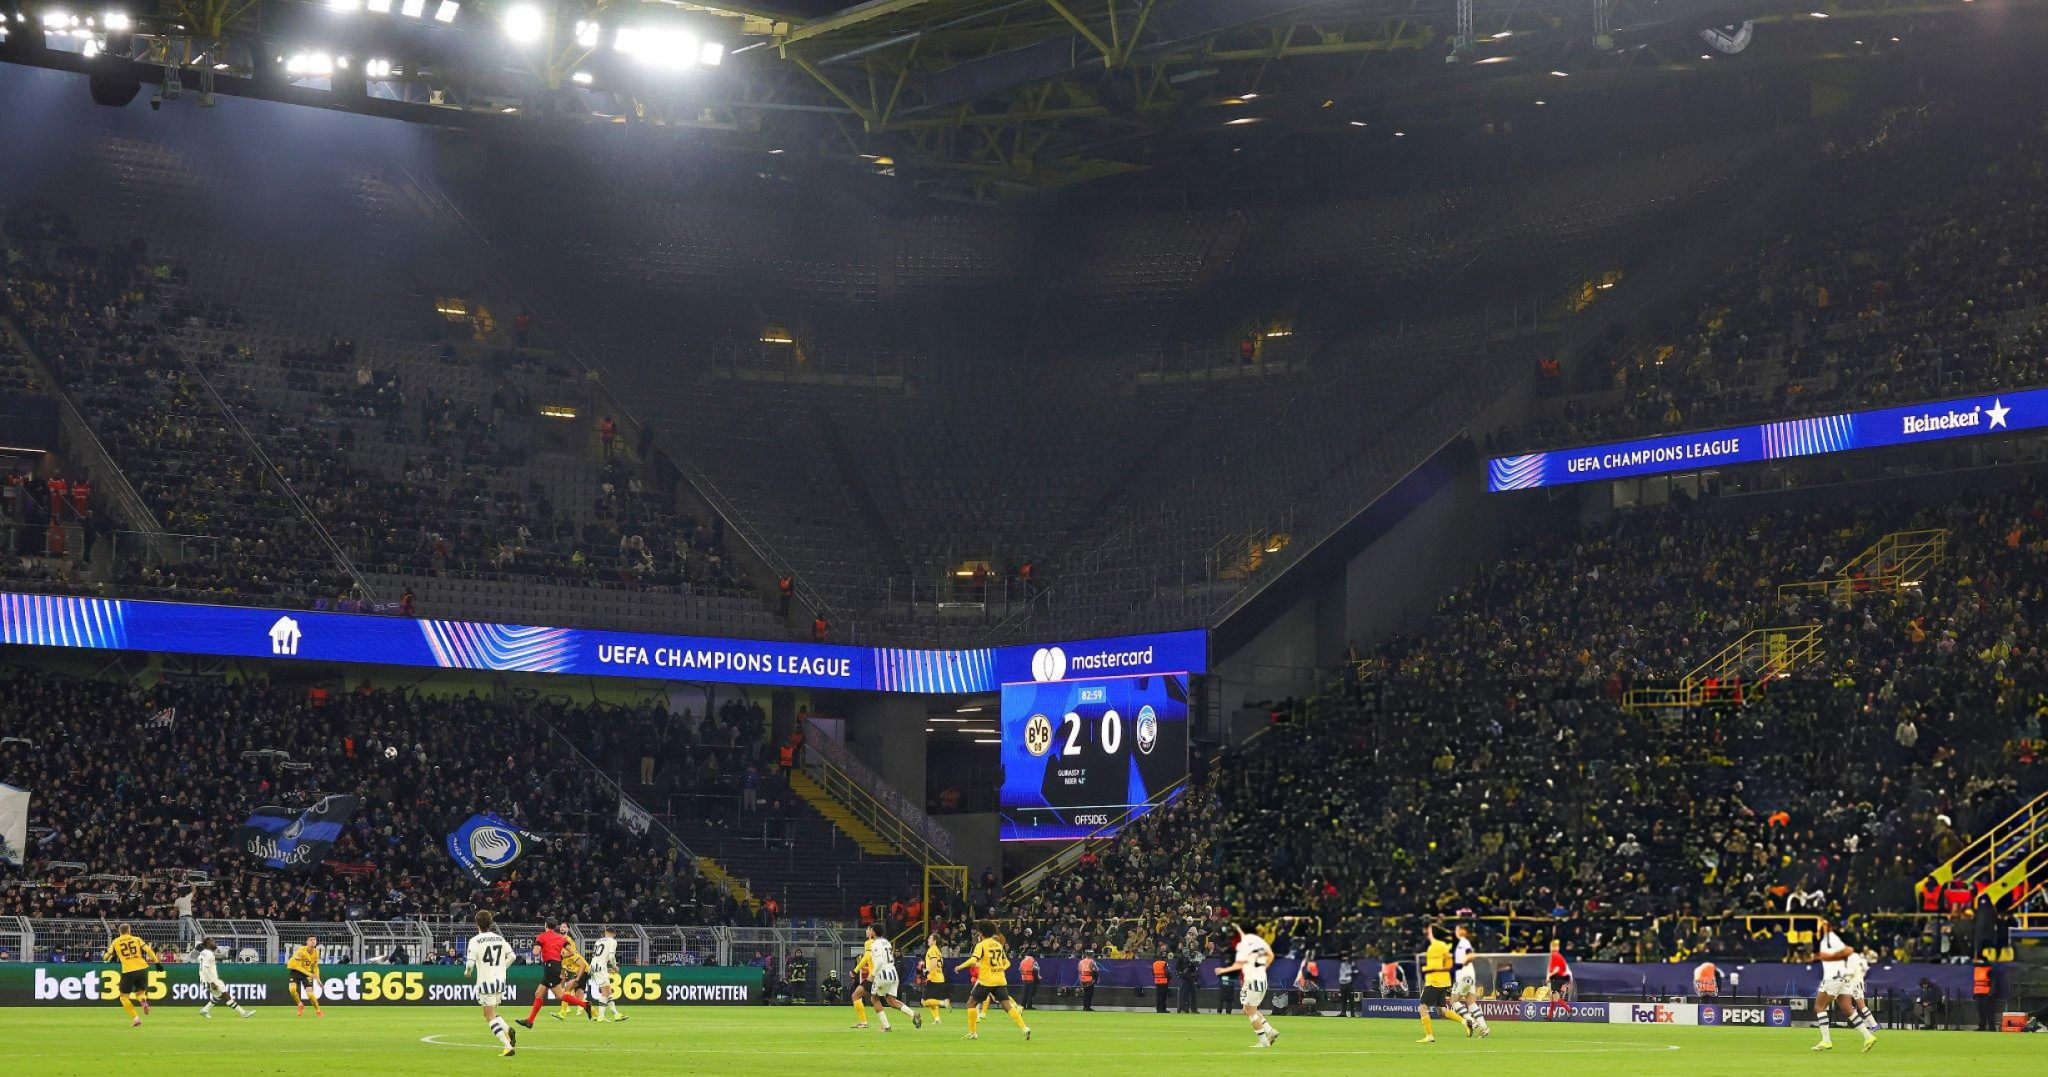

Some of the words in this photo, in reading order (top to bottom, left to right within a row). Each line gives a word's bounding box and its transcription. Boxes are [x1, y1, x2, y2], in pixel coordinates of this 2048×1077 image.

[1903, 410, 1979, 434] Heineken
[1568, 455, 1600, 472] UEFA
[1603, 445, 1683, 469] CHAMPIONS
[1686, 438, 1740, 460] LEAGUE
[598, 645, 649, 665] UEFA
[654, 648, 772, 672] CHAMPIONS
[777, 655, 851, 677] LEAGUE
[1072, 646, 1153, 670] mastercard
[1029, 719, 1048, 743] BVB
[1063, 712, 1082, 755] 2
[1101, 710, 1122, 754] 0
[1075, 815, 1108, 825] OFFSIDES
[119, 940, 137, 957] 26
[482, 944, 502, 967] 47
[34, 968, 168, 1000] bet35
[172, 983, 267, 1000] SPORETTEN
[428, 984, 517, 1000] SPORTWEN
[666, 985, 748, 1000] SPORTWETTEN
[1368, 1004, 1381, 1012] UEFA
[1540, 1004, 1605, 1018] crypo.com
[1632, 1005, 1674, 1023] FedEx
[1722, 1009, 1765, 1023] PEPSI
